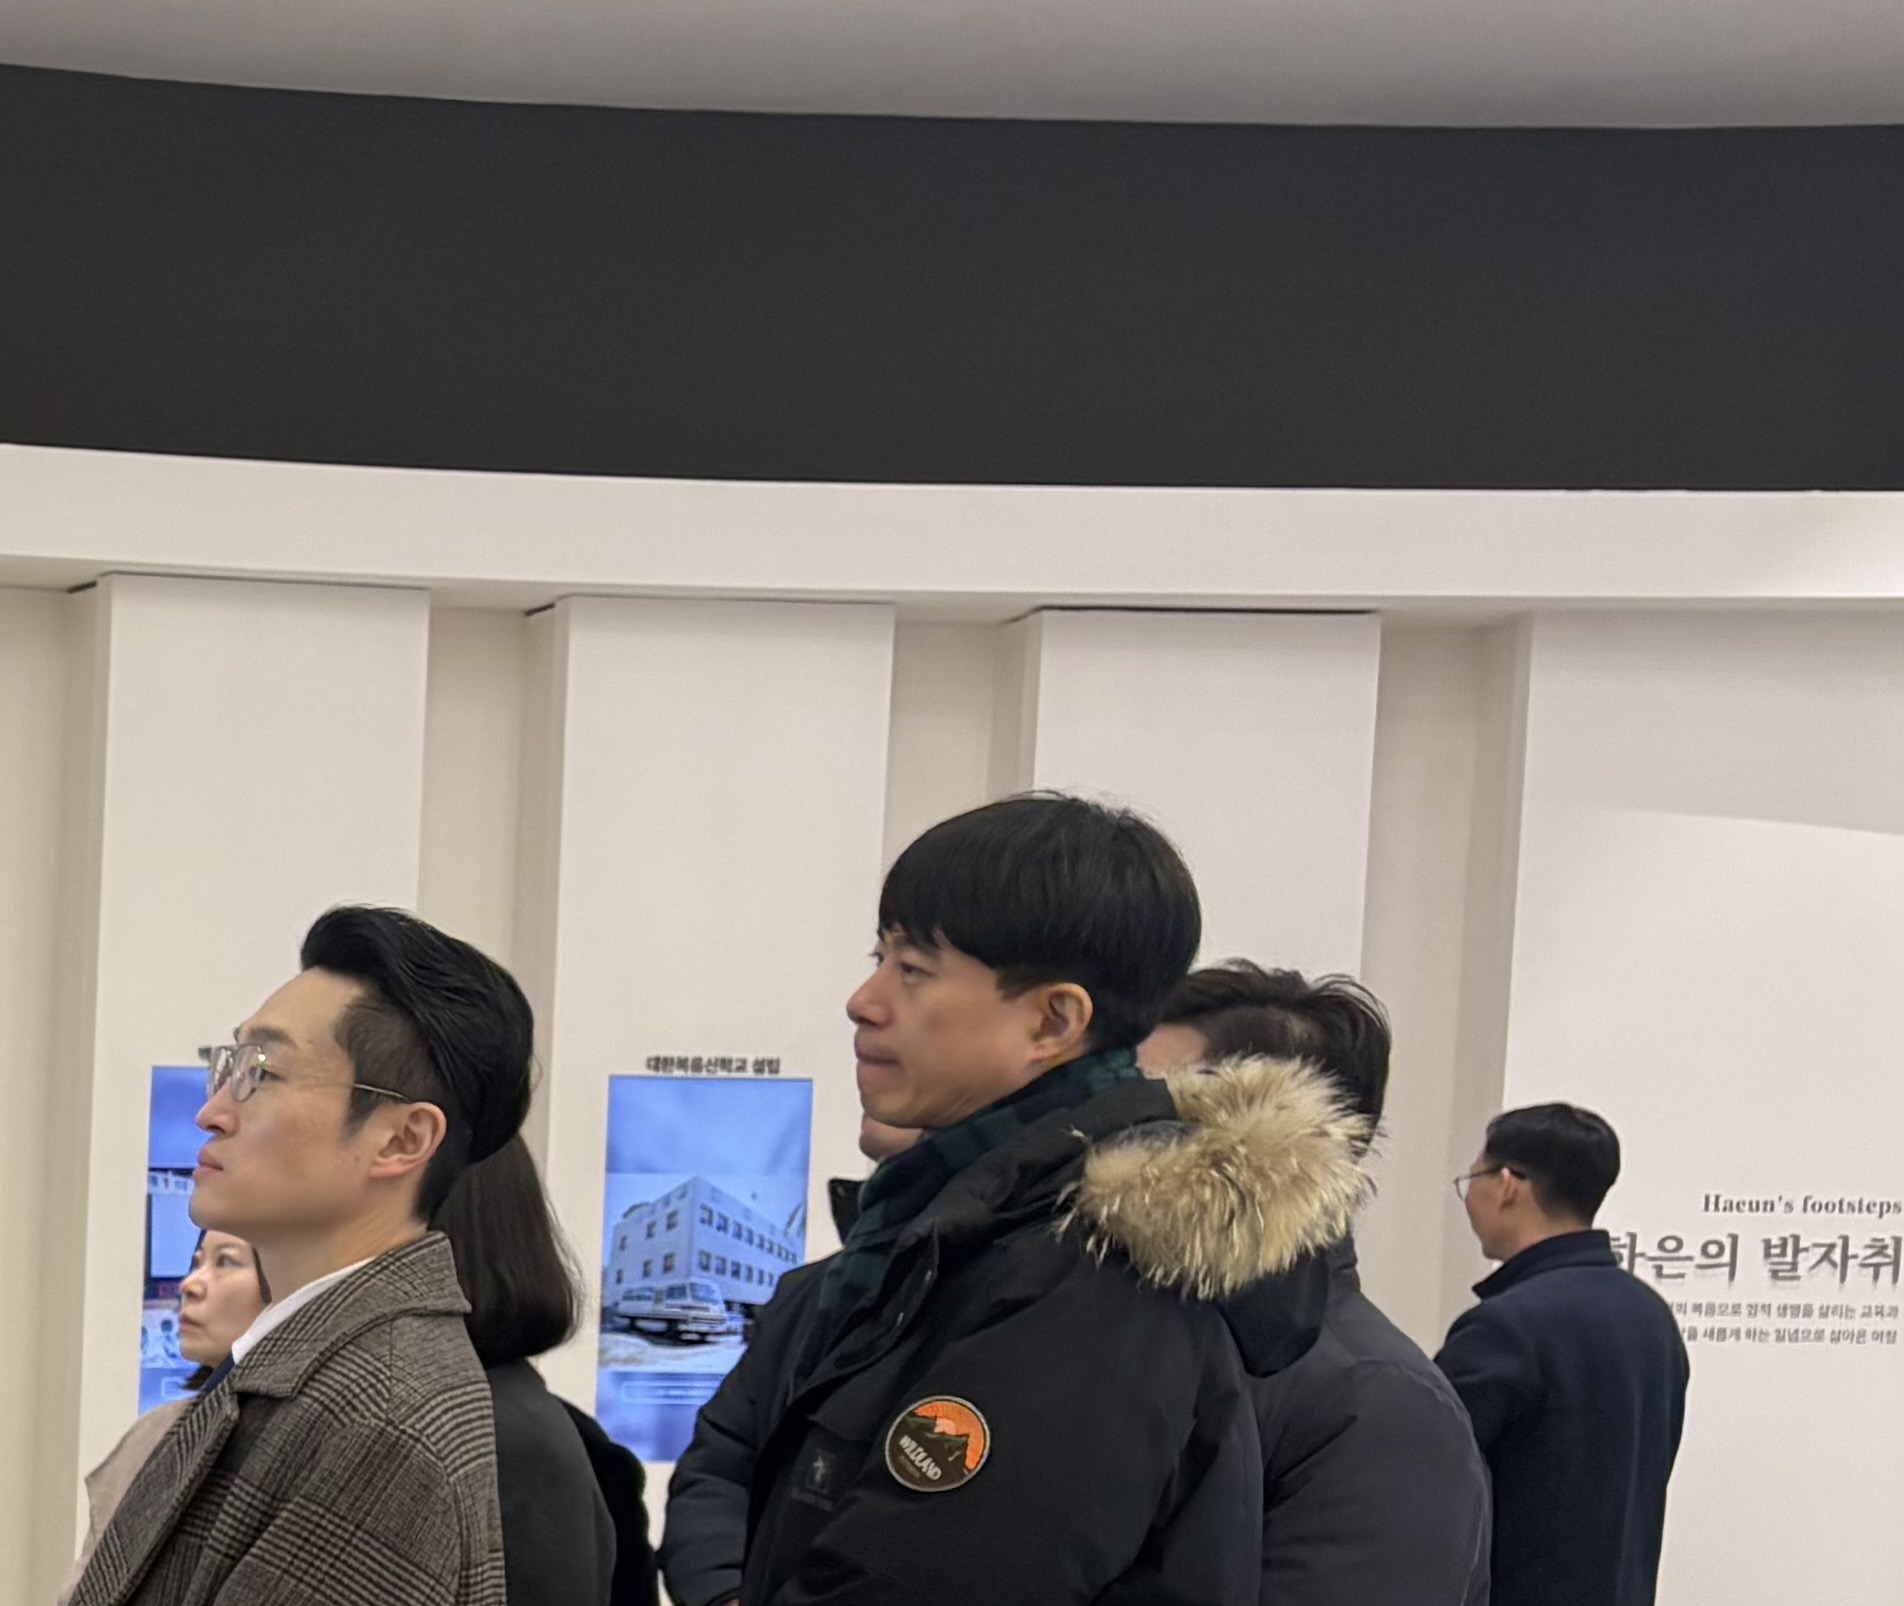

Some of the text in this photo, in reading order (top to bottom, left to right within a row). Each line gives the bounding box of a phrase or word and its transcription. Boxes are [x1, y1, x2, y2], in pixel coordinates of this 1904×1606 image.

[1703, 1193, 1903, 1219] Haeun's footsteps
[1609, 1231, 1903, 1286] 하은의 발자취
